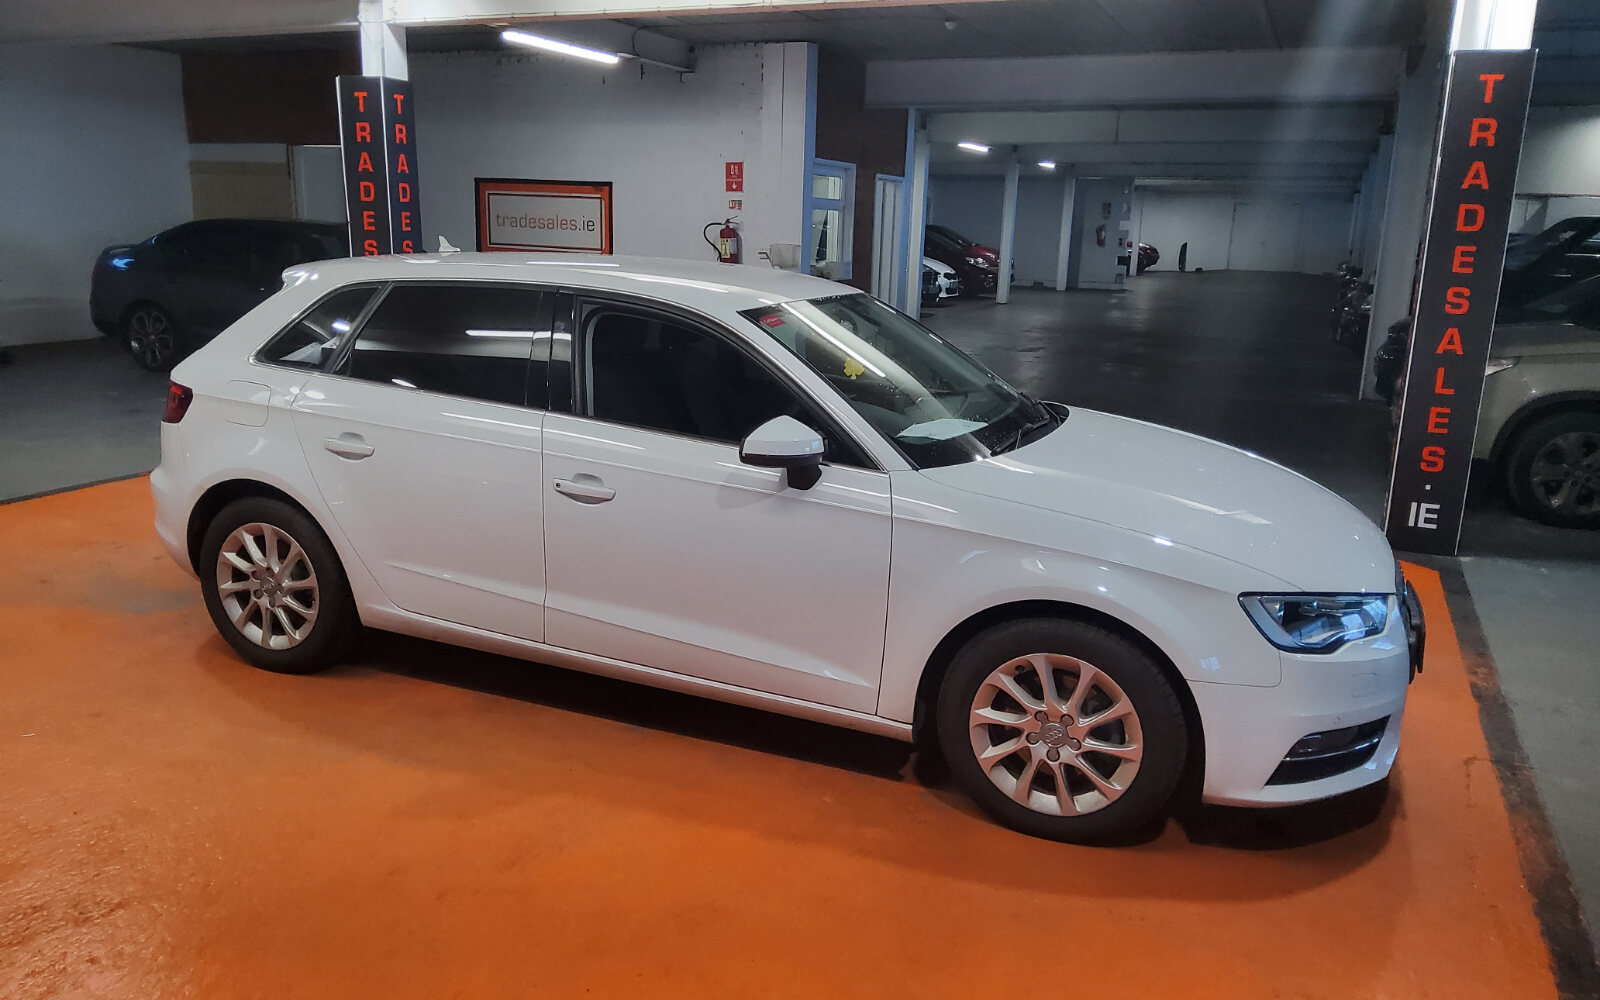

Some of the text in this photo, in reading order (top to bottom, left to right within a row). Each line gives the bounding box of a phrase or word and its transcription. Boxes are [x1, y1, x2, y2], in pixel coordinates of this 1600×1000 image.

[354, 92, 378, 257] TRADES
[393, 94, 413, 254] TRADES
[496, 213, 595, 232] tradesales.ie
